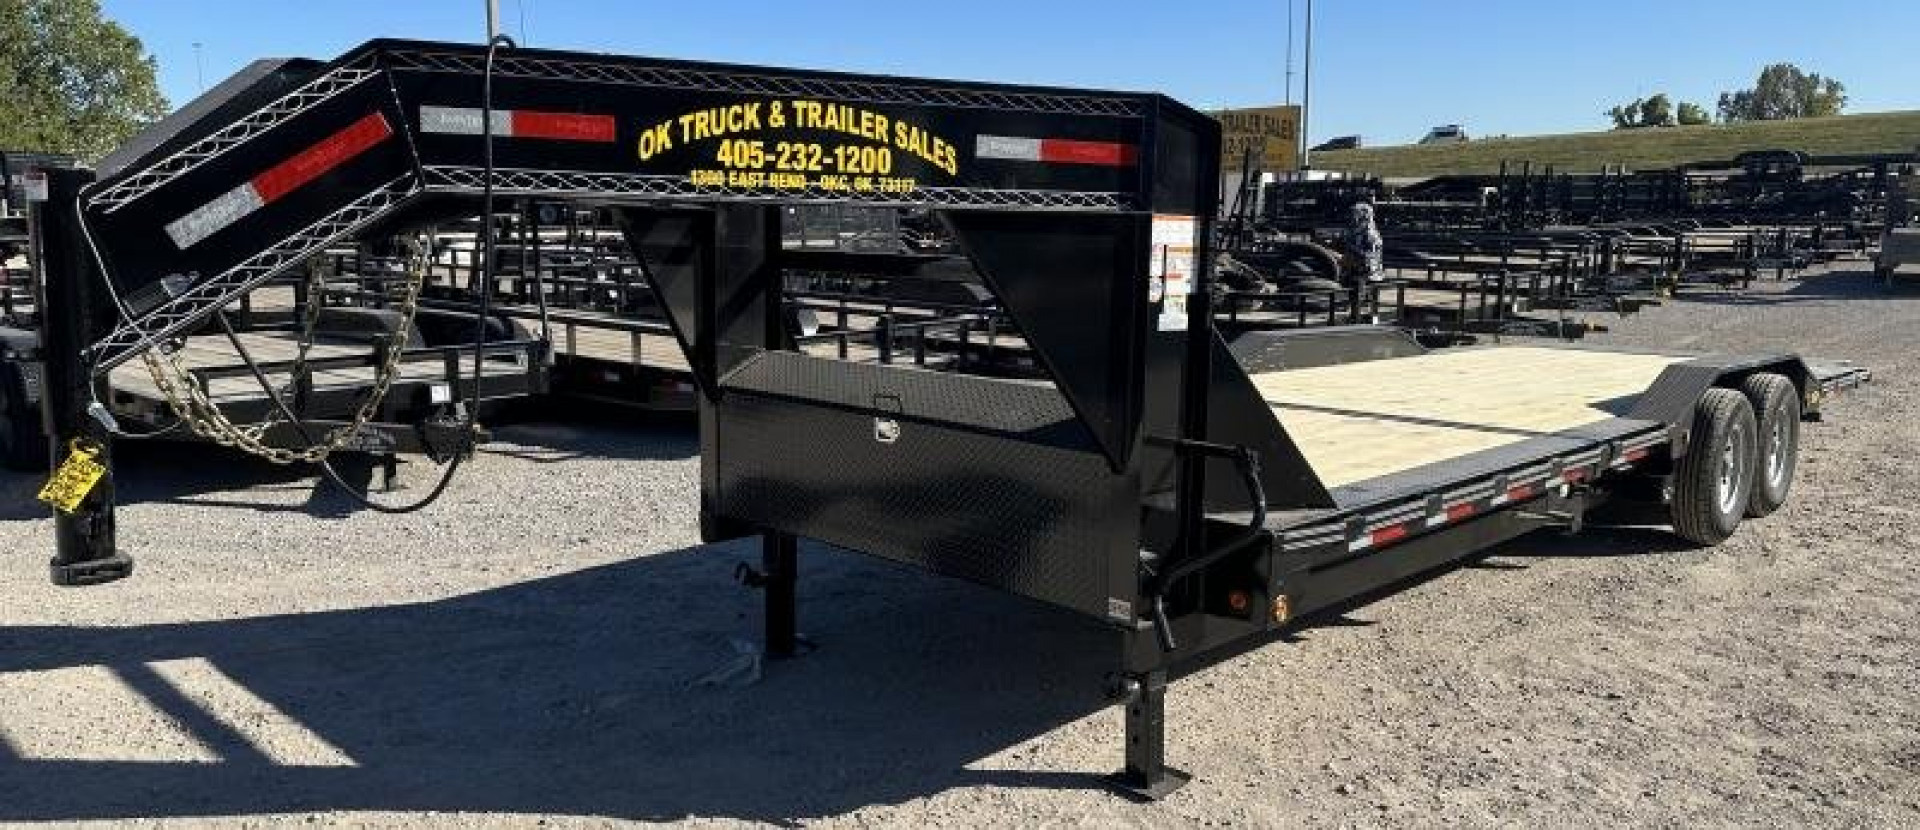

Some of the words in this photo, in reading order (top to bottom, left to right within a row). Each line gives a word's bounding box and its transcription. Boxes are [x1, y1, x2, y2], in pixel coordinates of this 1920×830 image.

[638, 120, 673, 160] OK
[679, 102, 762, 144] TRUCK
[768, 100, 786, 127] &
[792, 100, 889, 143] TRAILER
[895, 120, 958, 176] SALES
[717, 139, 892, 174] 405-232-1200
[729, 171, 766, 187] EAST
